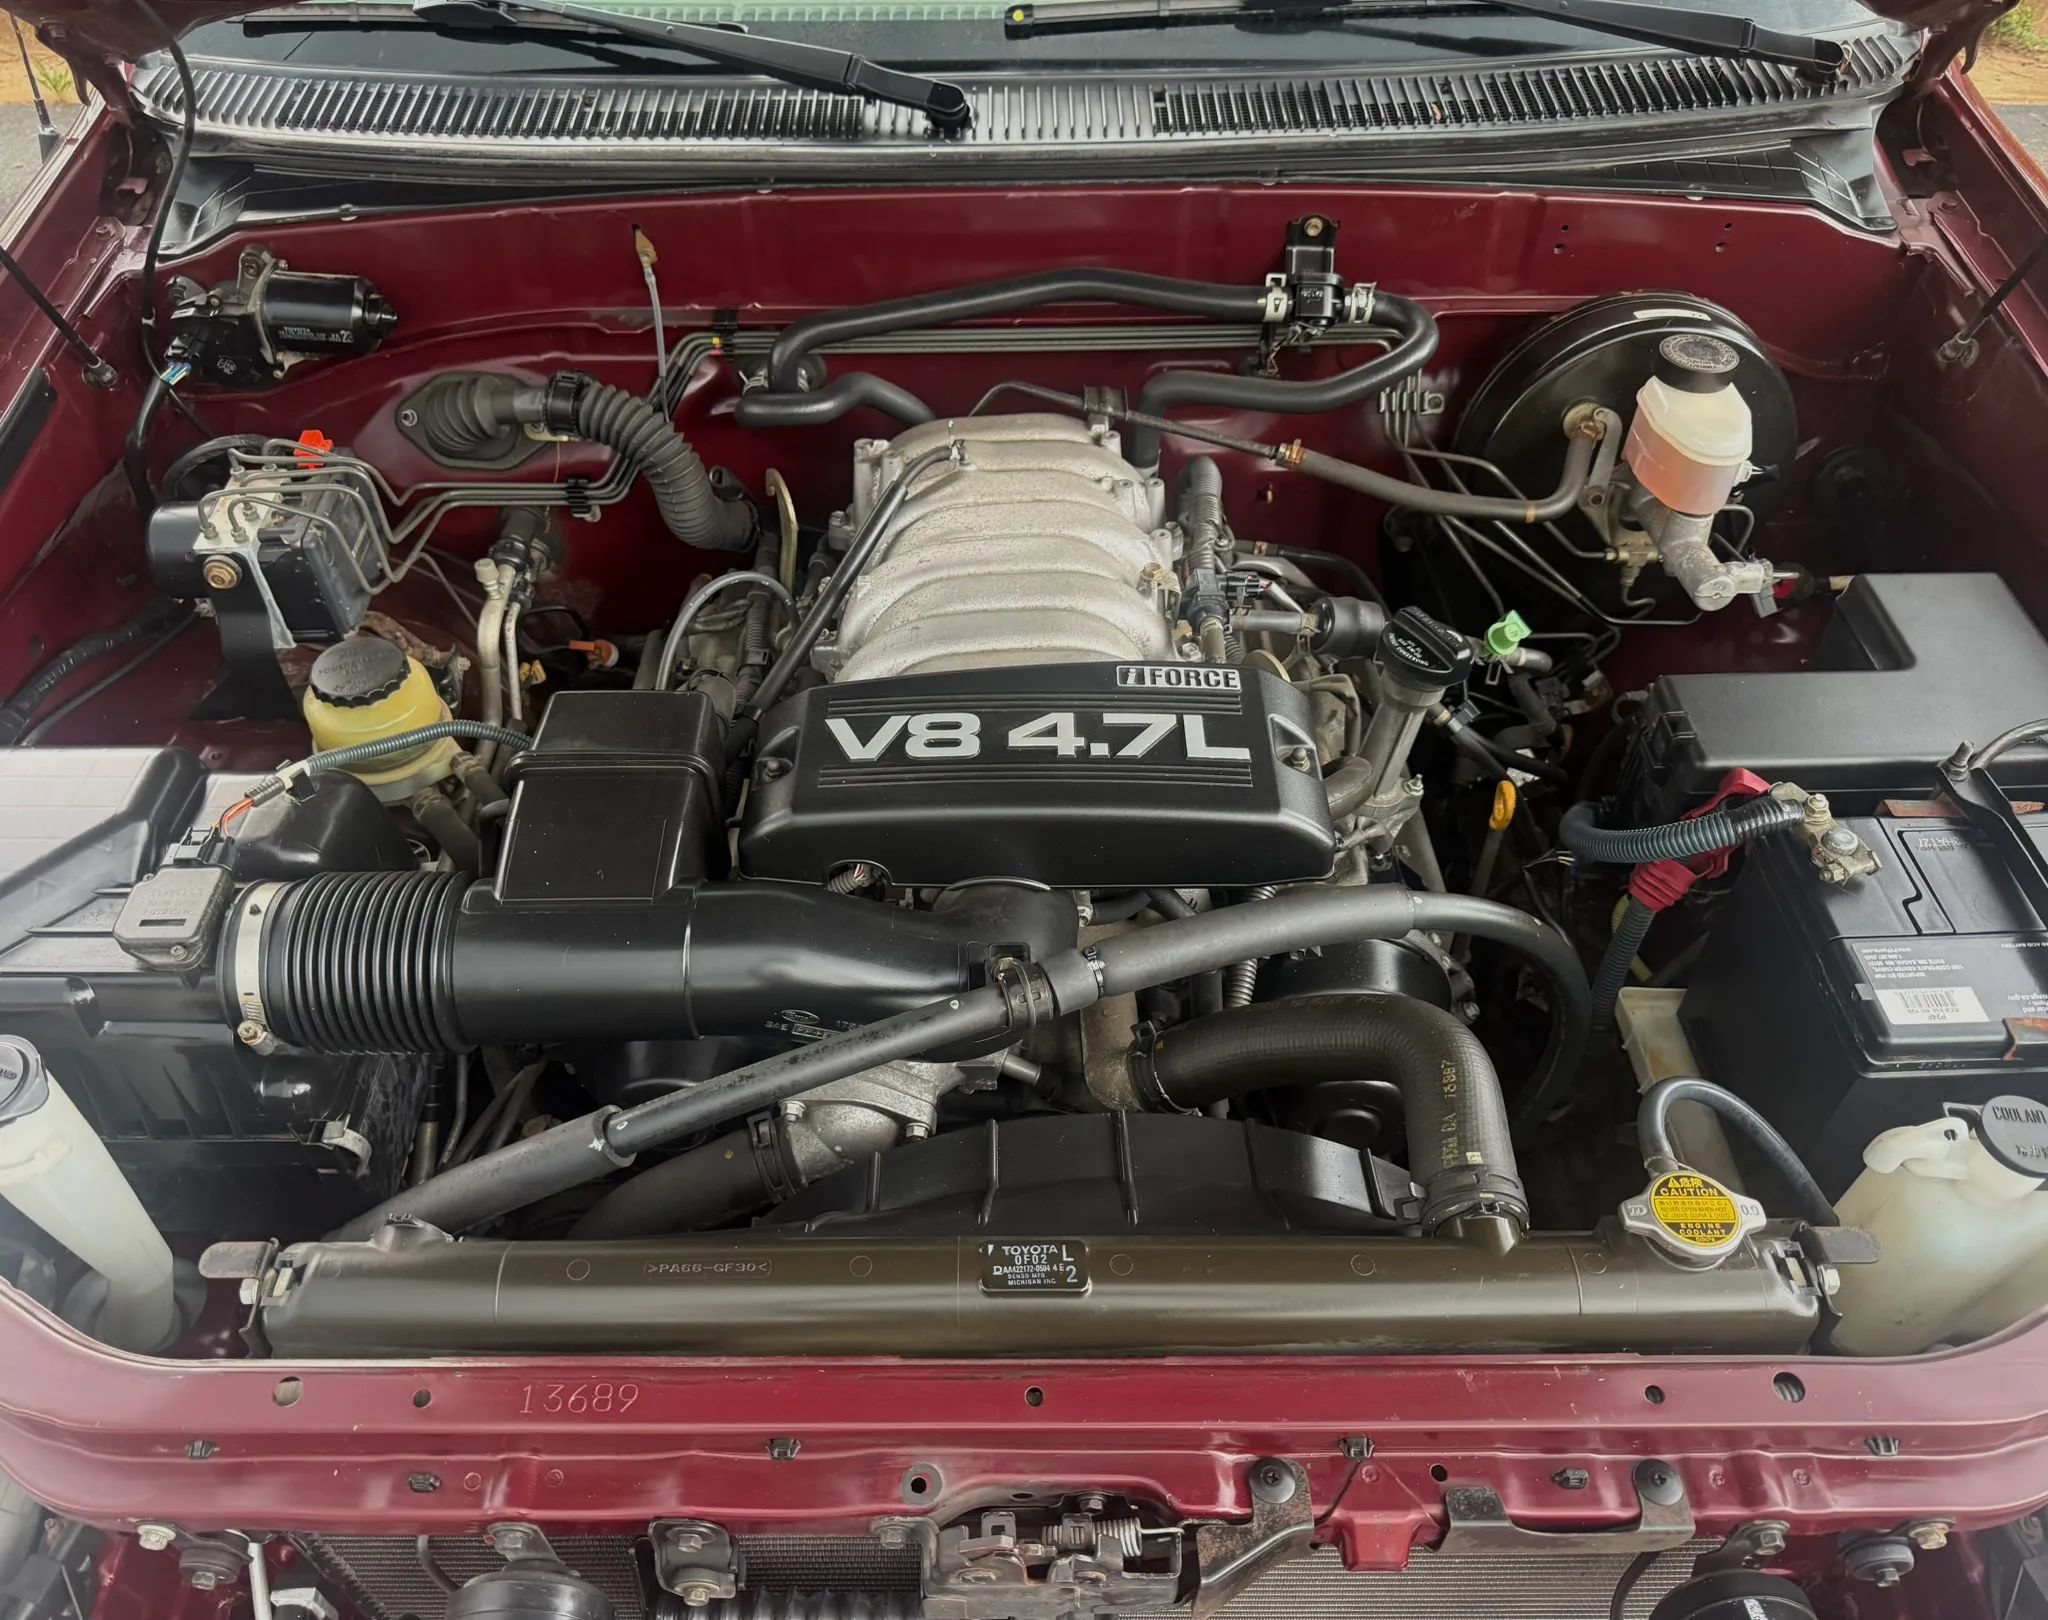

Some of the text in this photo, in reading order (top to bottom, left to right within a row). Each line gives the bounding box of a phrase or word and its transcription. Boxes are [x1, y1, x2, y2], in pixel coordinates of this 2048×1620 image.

[1149, 668, 1239, 689] FORCE
[824, 712, 1252, 762] V8 4.7L
[1992, 1105, 2048, 1124] COOLANT
[1660, 1188, 1719, 1197] CAUTION
[1741, 1205, 1760, 1217] 0.9
[1002, 1244, 1058, 1256] TOYOTA
[1062, 1244, 1075, 1261] L
[1015, 1254, 1048, 1265] 0F02
[1065, 1265, 1078, 1283] 2
[519, 1383, 640, 1414] 13689
